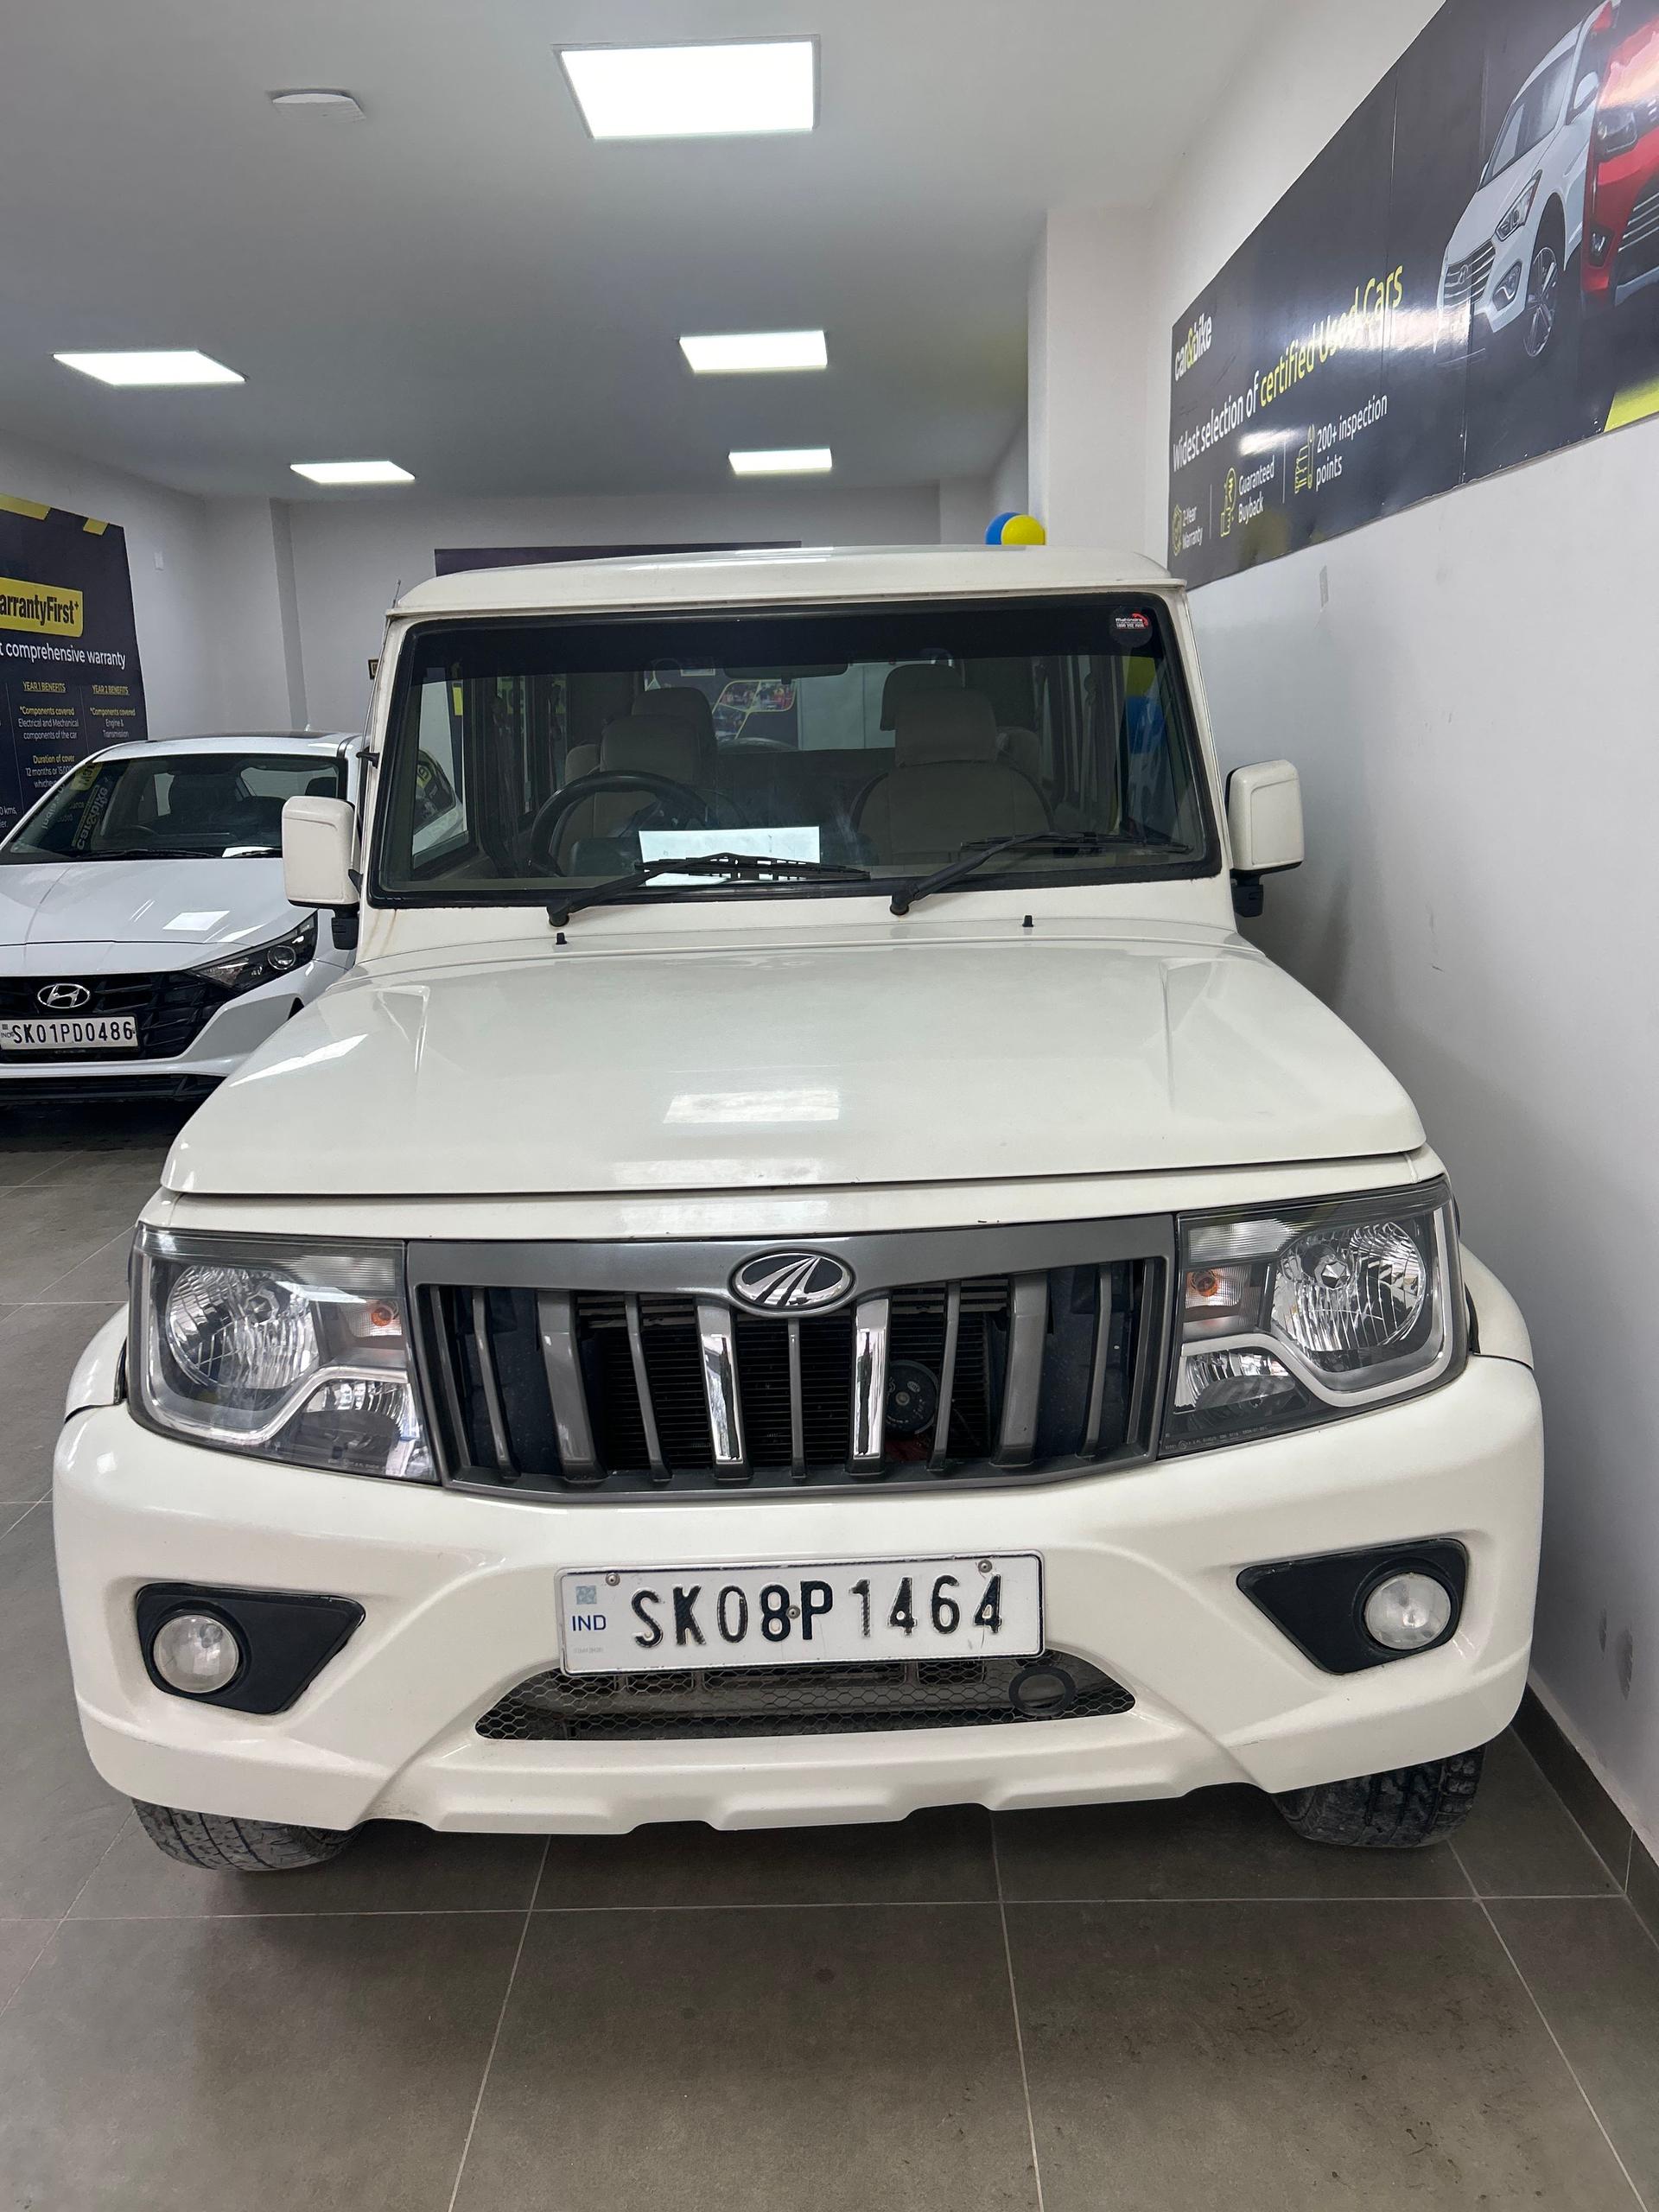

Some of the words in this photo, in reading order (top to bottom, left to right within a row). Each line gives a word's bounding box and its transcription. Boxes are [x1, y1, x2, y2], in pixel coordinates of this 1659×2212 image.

[1174, 313, 1212, 381] car&bike
[1173, 425, 1200, 472] Widest
[1201, 395, 1243, 453] selection
[1246, 370, 1260, 417] of
[1260, 322, 1315, 407] certified
[1319, 286, 1359, 364] Used
[1363, 265, 1403, 327] Cars
[1317, 423, 1337, 454] 200+
[1338, 394, 1388, 441] inspection
[1239, 454, 1275, 496] Guaranteed
[1316, 454, 1343, 492] points
[1182, 506, 1197, 527] 2-Year
[1238, 491, 1264, 524] Buyback
[1182, 525, 1203, 550] Warranty
[6, 642, 86, 663] comprehensive
[86, 650, 126, 670] warranty
[22, 681, 37, 692] YEAR
[41, 682, 67, 693] BENEFITS
[92, 684, 104, 695] YEAR
[108, 685, 130, 696] BENEFITS
[55, 707, 75, 716] covered
[18, 718, 41, 728] Electrical
[42, 718, 52, 728] and
[53, 718, 79, 728] Mechanical
[105, 718, 120, 729] Engine
[23, 731, 55, 741] components
[55, 730, 60, 740] of
[60, 730, 69, 739] the
[33, 754, 56, 765] Duration
[56, 753, 61, 763] of
[61, 754, 75, 763] cover
[26, 767, 32, 777] 12
[32, 766, 52, 776] months
[12, 1021, 134, 1044] SK01PD0486
[631, 1573, 1002, 1648] SK08P1464
[571, 1614, 607, 1632] IND
